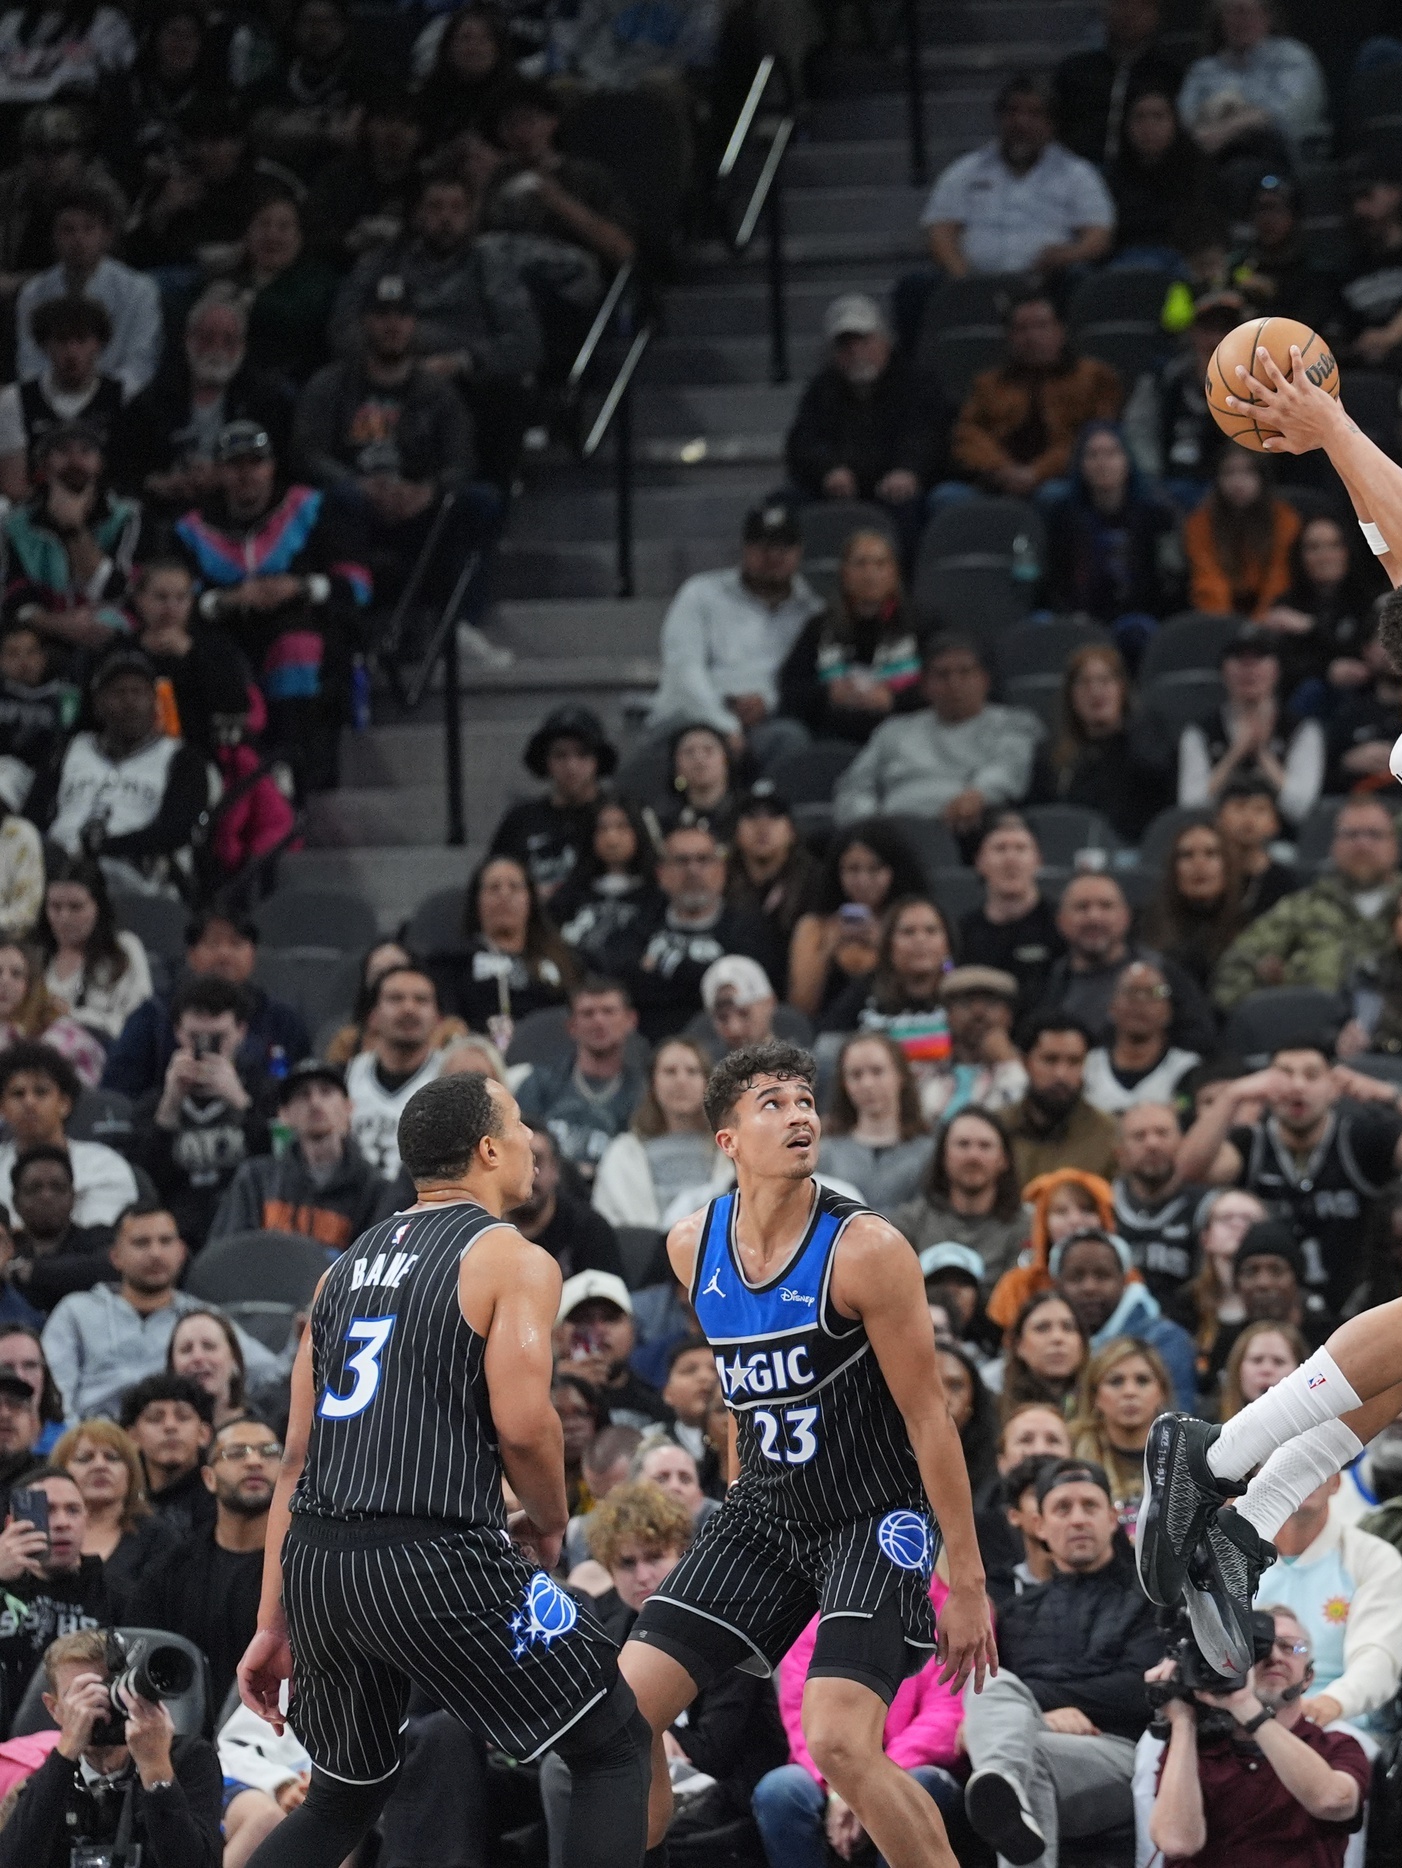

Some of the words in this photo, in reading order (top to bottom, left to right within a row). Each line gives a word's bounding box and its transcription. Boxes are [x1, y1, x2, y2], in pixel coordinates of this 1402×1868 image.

[350, 1252, 419, 1291] BANE
[318, 1315, 397, 1420] 3
[753, 1405, 819, 1465] 23
